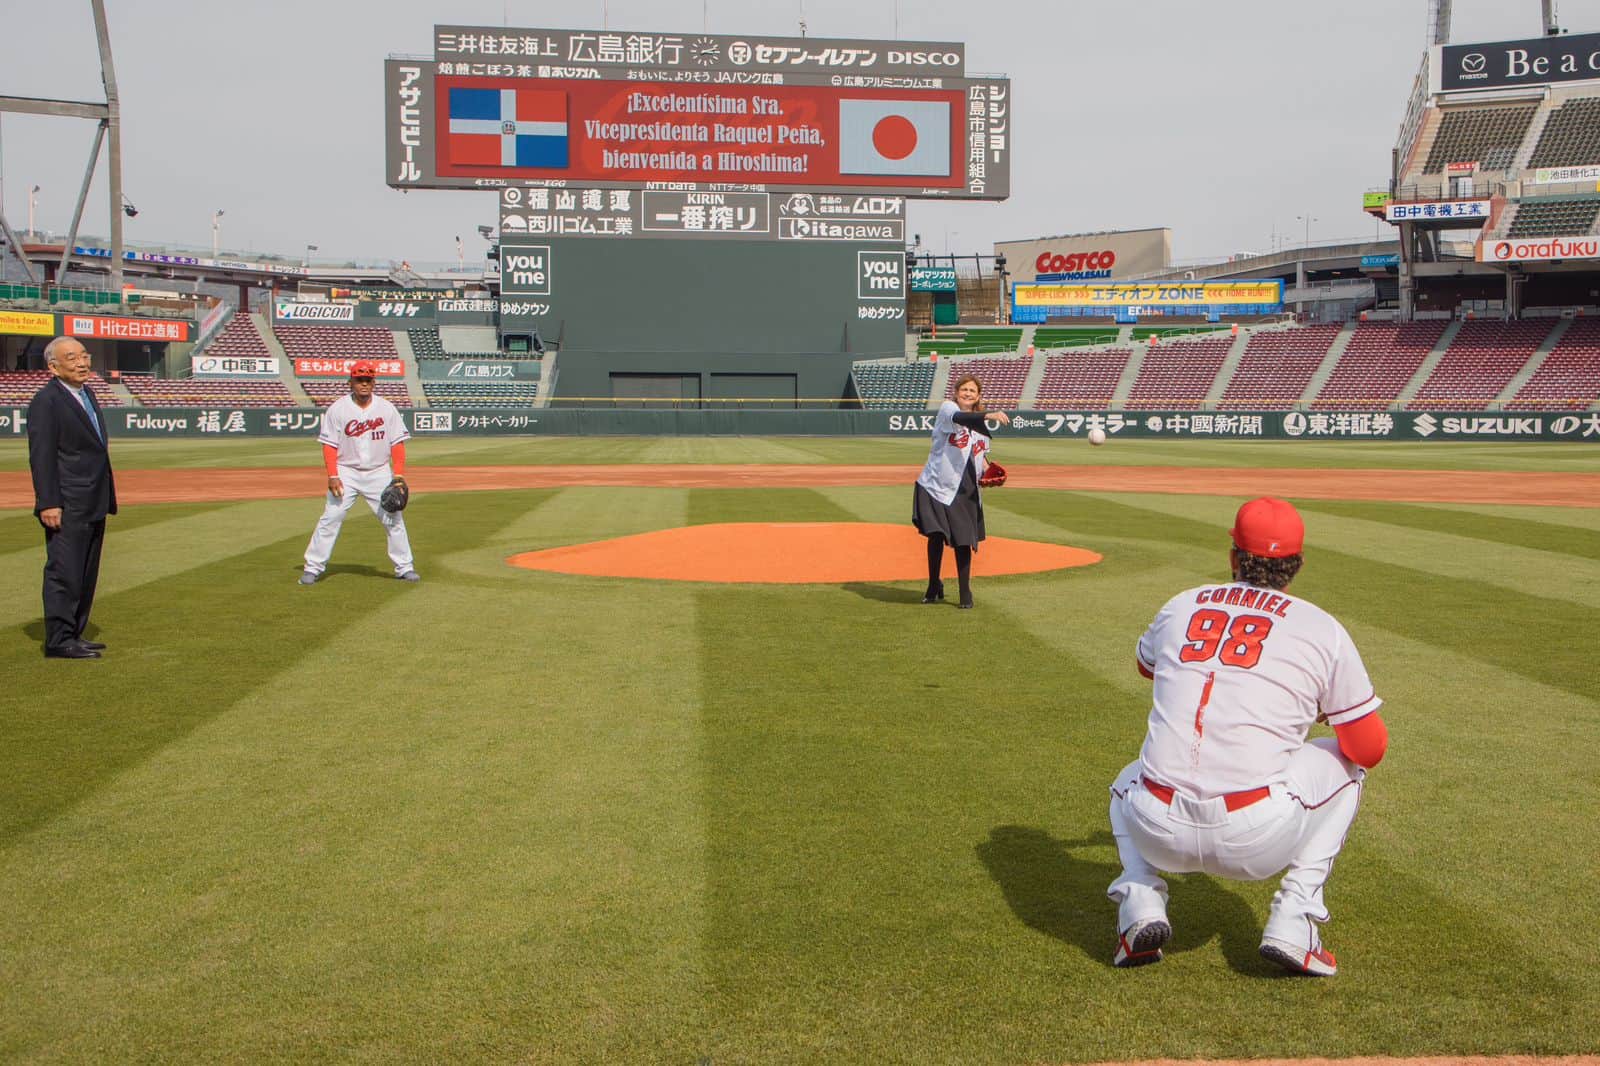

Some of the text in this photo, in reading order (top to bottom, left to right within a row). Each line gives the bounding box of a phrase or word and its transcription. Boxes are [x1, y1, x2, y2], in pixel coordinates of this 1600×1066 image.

[438, 34, 559, 57] 三井住友海上
[568, 33, 684, 65] 広島銀行
[887, 51, 960, 66] DISCO
[1505, 49, 1549, 78] Be
[1560, 54, 1579, 73] a
[438, 62, 532, 77] 焙煎ごぼう茶
[627, 69, 784, 84] おもいに、よりそう JAバンク広島
[844, 76, 942, 89] 広島アルミニウム工業
[627, 92, 784, 115] ¡Excelentísima Sra.
[398, 67, 421, 181] アサヒビール
[584, 120, 825, 147] Vicepresidenta Raquel Peña,
[969, 85, 986, 193] 広島市信用組合
[602, 149, 808, 173] bienvenida a Hiroshima!
[528, 188, 631, 211] 福山通運
[687, 194, 725, 205] KIRIN
[852, 197, 903, 215] ムロオ
[655, 206, 756, 230] 一番搾り
[1393, 203, 1482, 218] 田中電機工業
[528, 215, 633, 235] 西川ゴム工業
[506, 255, 543, 272] you
[863, 260, 898, 277] you
[1036, 250, 1116, 273] COSTCO
[513, 270, 545, 285] me
[870, 275, 900, 289] me
[1058, 270, 1112, 281] WHOLESALE
[1092, 287, 1204, 300] エディオン ZONE
[1226, 288, 1246, 297] HOME
[293, 306, 351, 318] LOGICOM
[378, 303, 420, 317] サタケ
[501, 302, 550, 316] ゆめタウン
[858, 306, 904, 320] ゆめタウン
[100, 320, 179, 338] Hitz日立造船
[222, 358, 274, 372] 中電工
[465, 365, 514, 377] 広島ガス
[126, 410, 247, 432] Fukuya 福屋
[458, 416, 538, 428] タカキベーカリー
[1045, 414, 1137, 433] フマキラー
[1166, 414, 1263, 434] 中國新聞
[1308, 413, 1394, 435] 東洋証券
[1442, 417, 1542, 434] SUZUKI
[371, 430, 385, 441] 117
[1195, 587, 1293, 618] CORNIEL
[1179, 608, 1274, 669] 98
